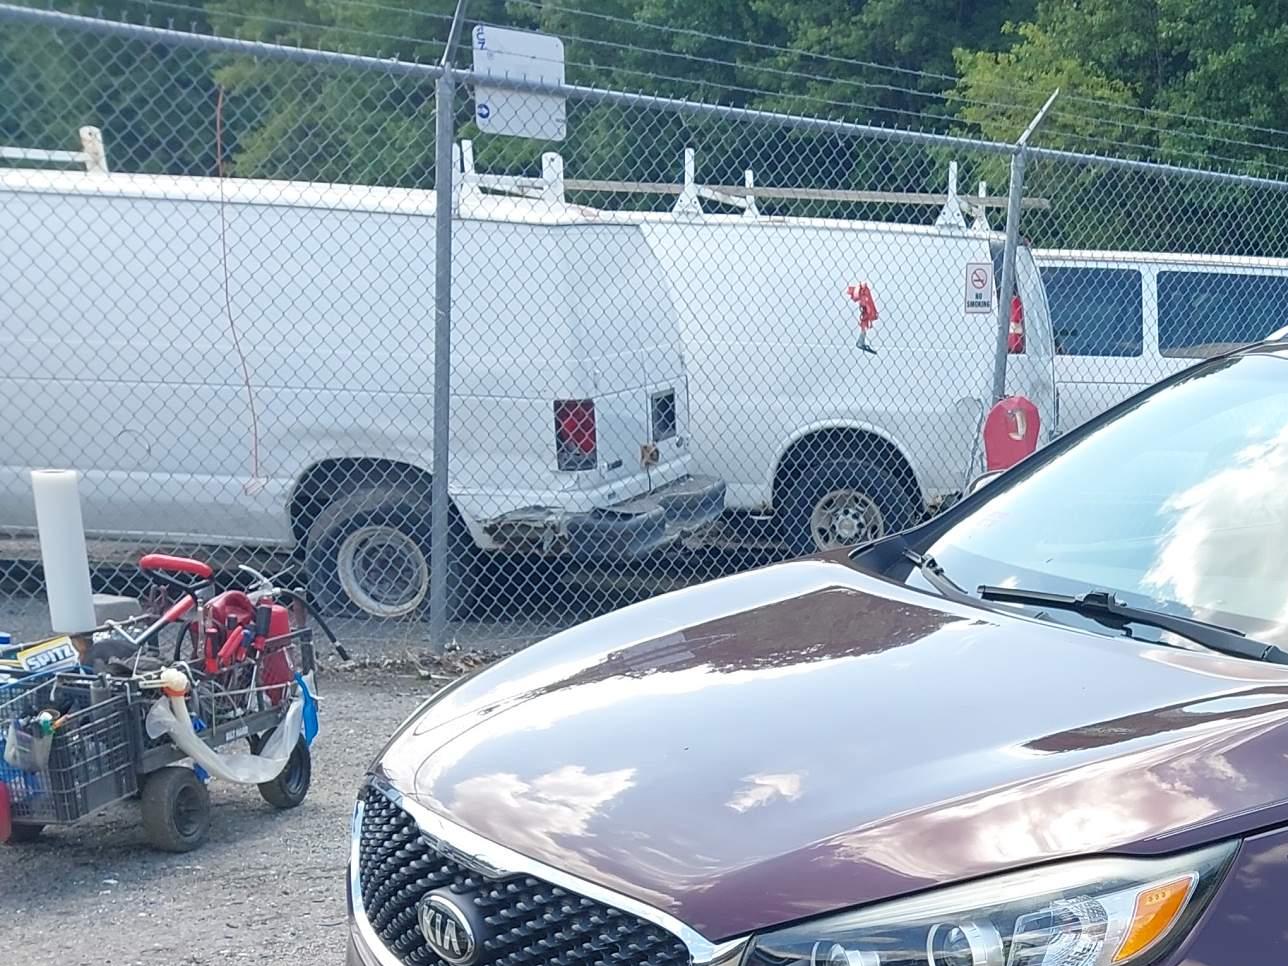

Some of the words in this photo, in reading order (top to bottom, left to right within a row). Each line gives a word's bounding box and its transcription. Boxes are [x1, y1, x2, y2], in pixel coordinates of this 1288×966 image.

[966, 300, 990, 308] SMOKING
[975, 292, 983, 300] NO
[26, 643, 76, 669] SPITZ
[422, 903, 462, 955] KIA
